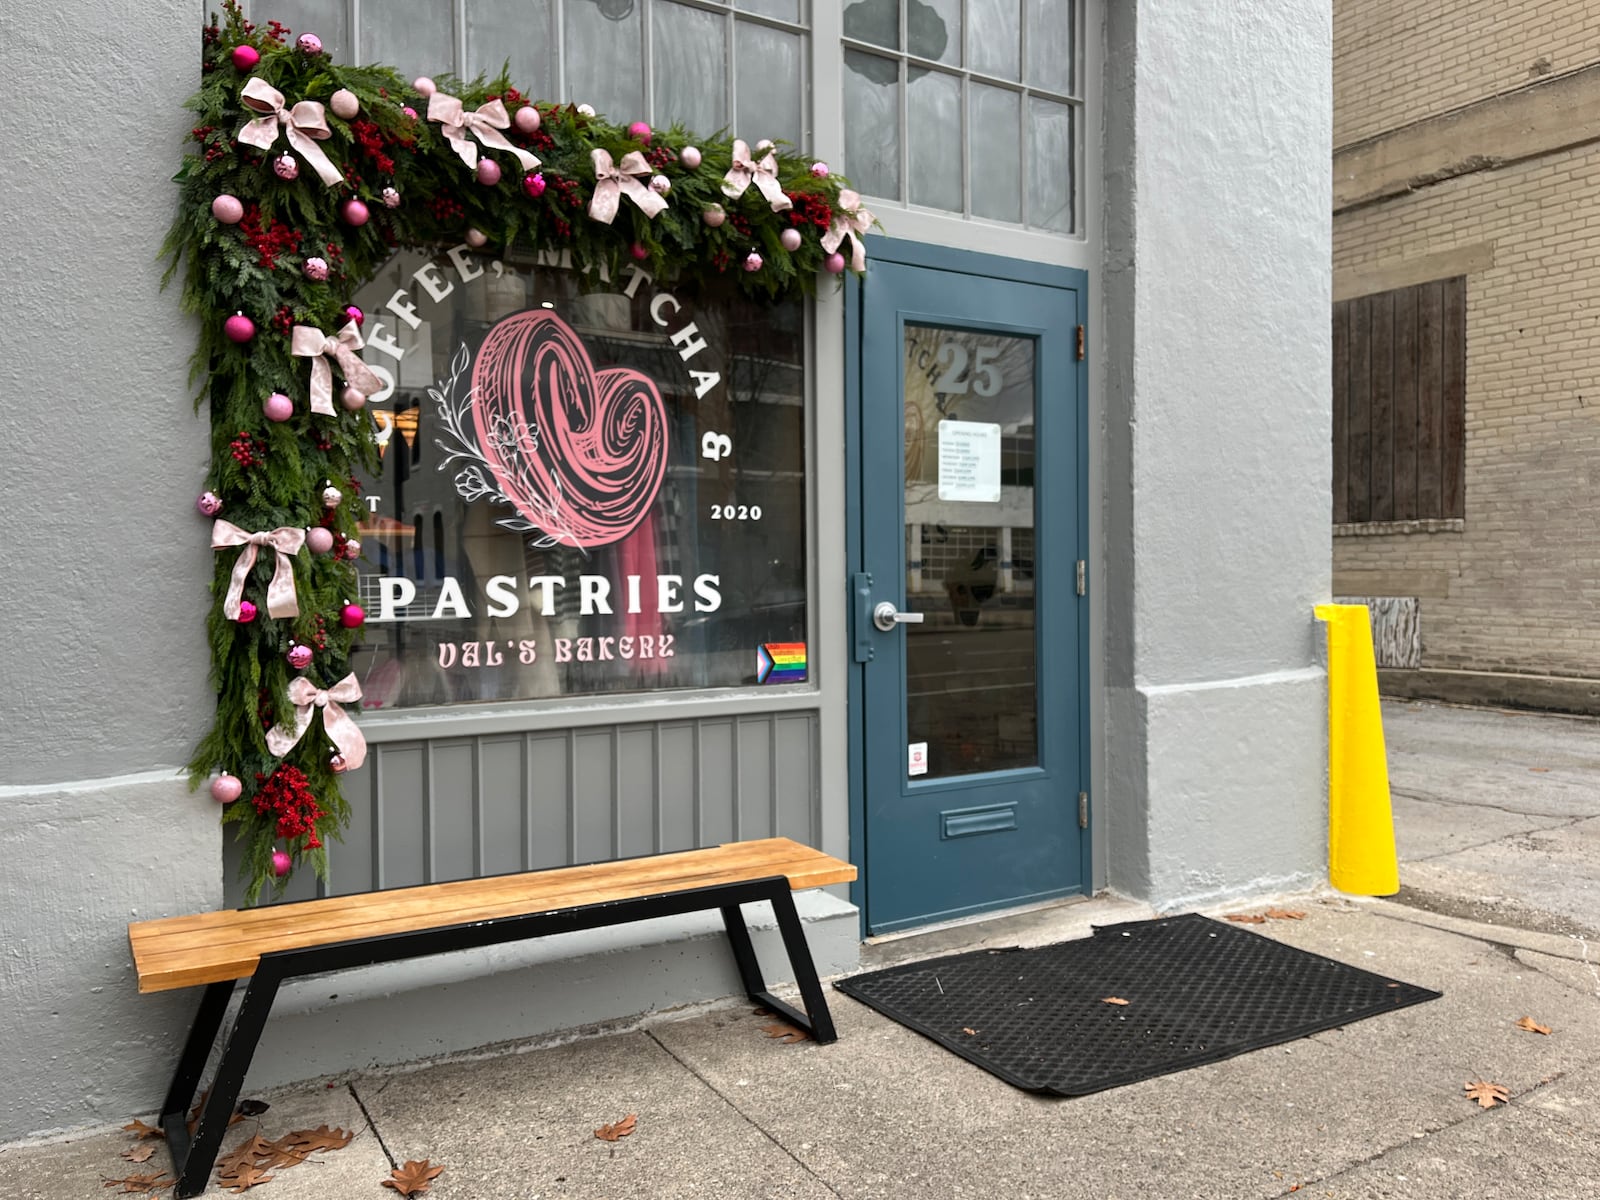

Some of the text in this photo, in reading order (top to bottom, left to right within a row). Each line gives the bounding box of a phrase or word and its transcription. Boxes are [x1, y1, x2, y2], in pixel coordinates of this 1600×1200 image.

[937, 342, 1003, 397] 25
[702, 431, 732, 461] &
[711, 504, 762, 520] 2020
[378, 573, 722, 619] PASTRIES
[438, 634, 675, 669] VAL'S BAKERY
